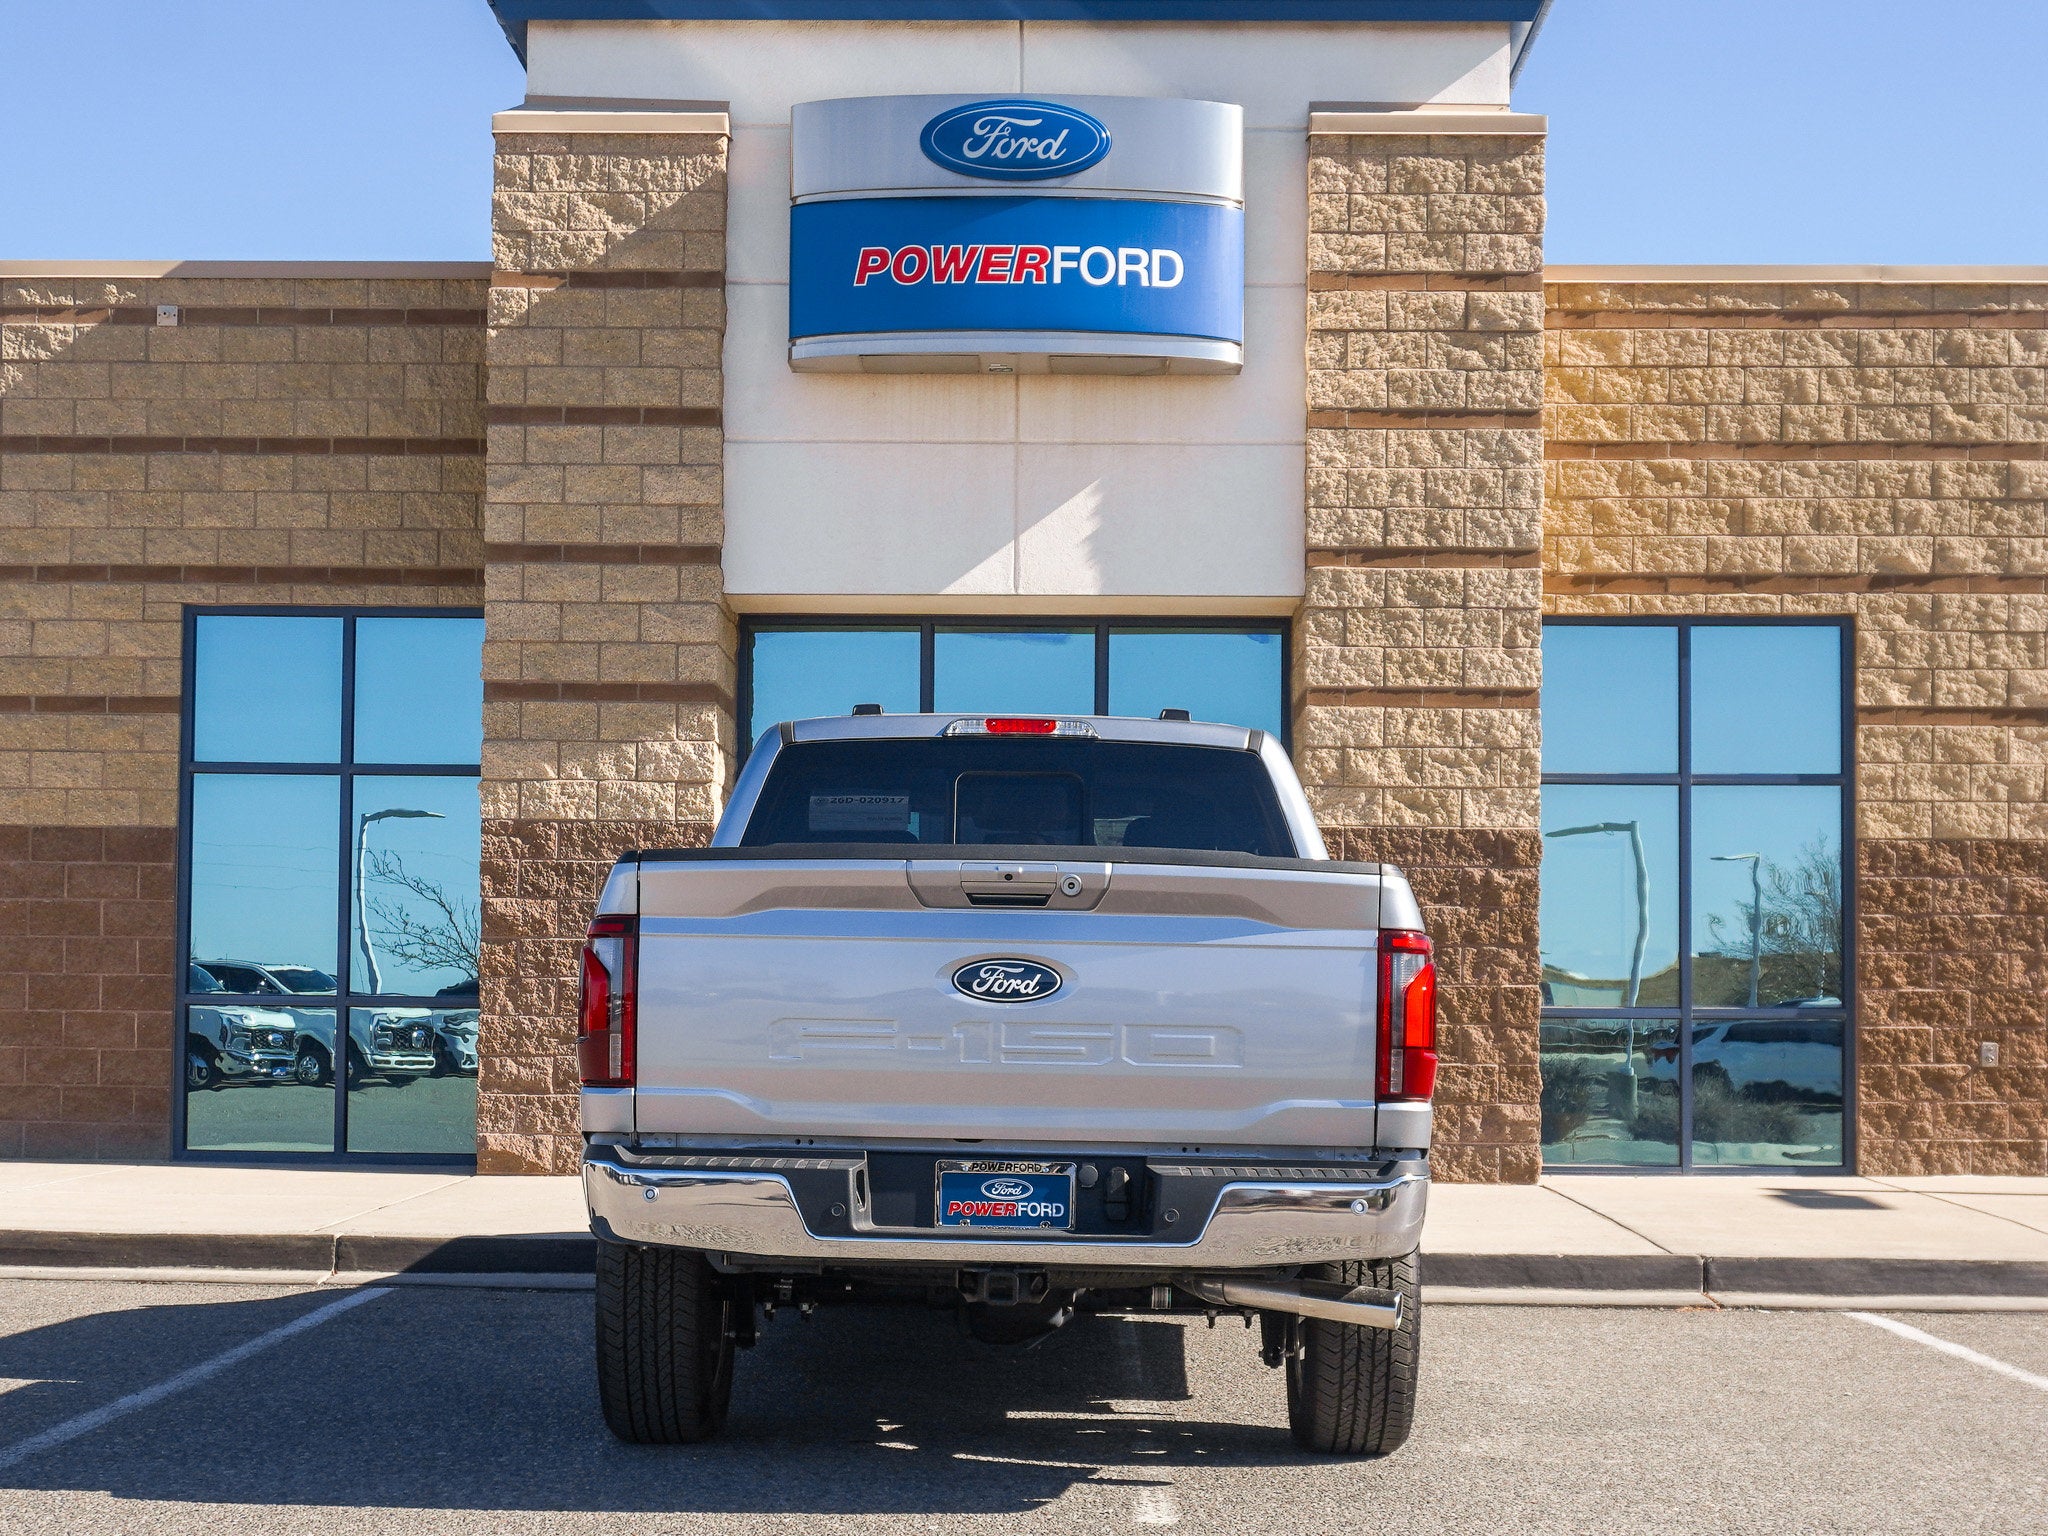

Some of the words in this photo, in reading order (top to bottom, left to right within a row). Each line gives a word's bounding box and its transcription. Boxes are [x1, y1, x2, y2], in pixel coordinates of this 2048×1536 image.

[962, 115, 1070, 161] Ford
[972, 962, 1040, 996] Ford
[768, 1017, 1245, 1068] F-150
[991, 1182, 1023, 1197] Ford
